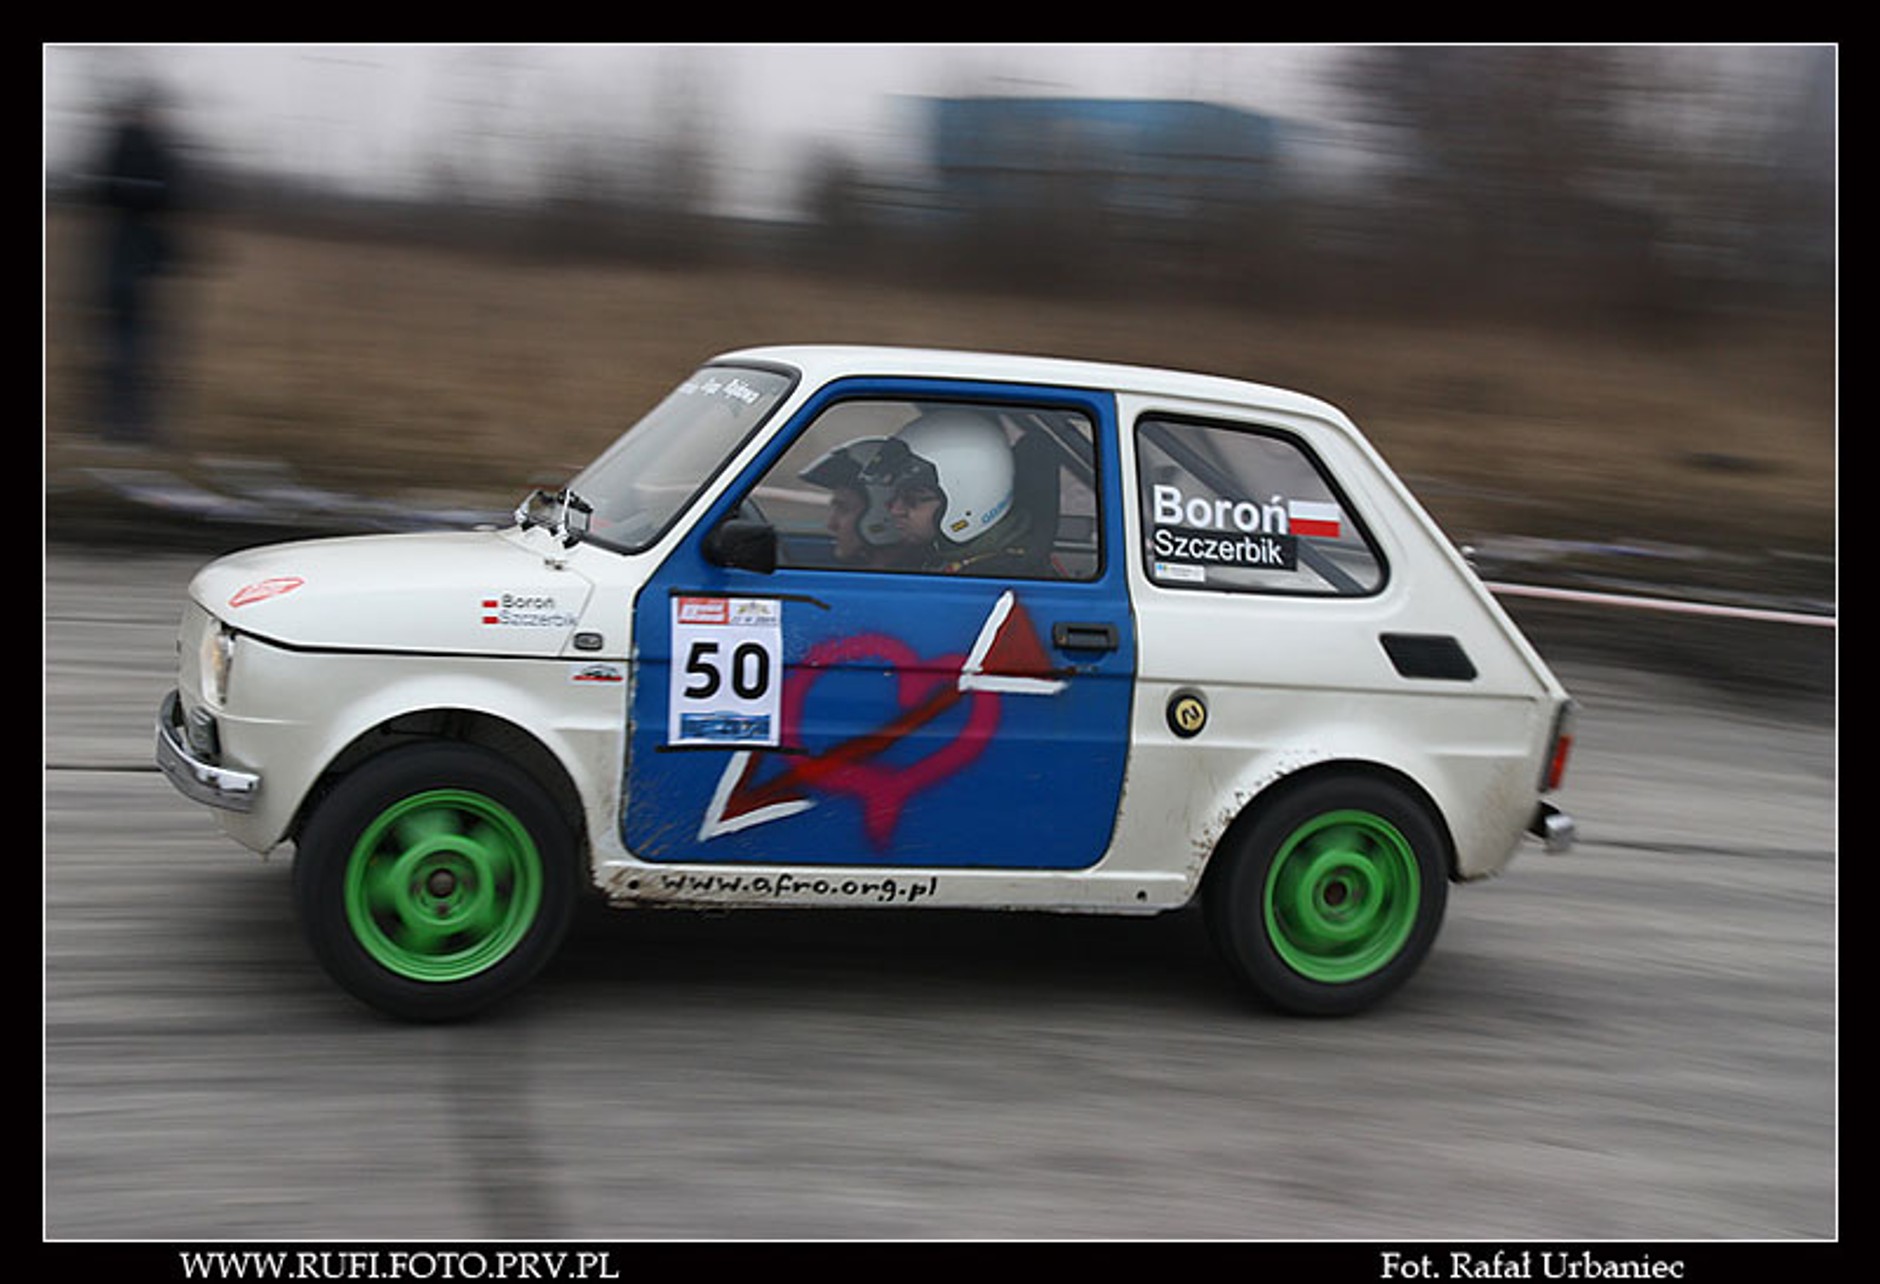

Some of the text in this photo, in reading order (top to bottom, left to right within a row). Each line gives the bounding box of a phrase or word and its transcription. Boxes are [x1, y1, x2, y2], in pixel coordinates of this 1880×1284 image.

[1153, 485, 1287, 535] Boroń
[1154, 529, 1284, 565] Szczerbik
[684, 642, 770, 700] 50
[661, 873, 937, 901] www.afro.org.pl
